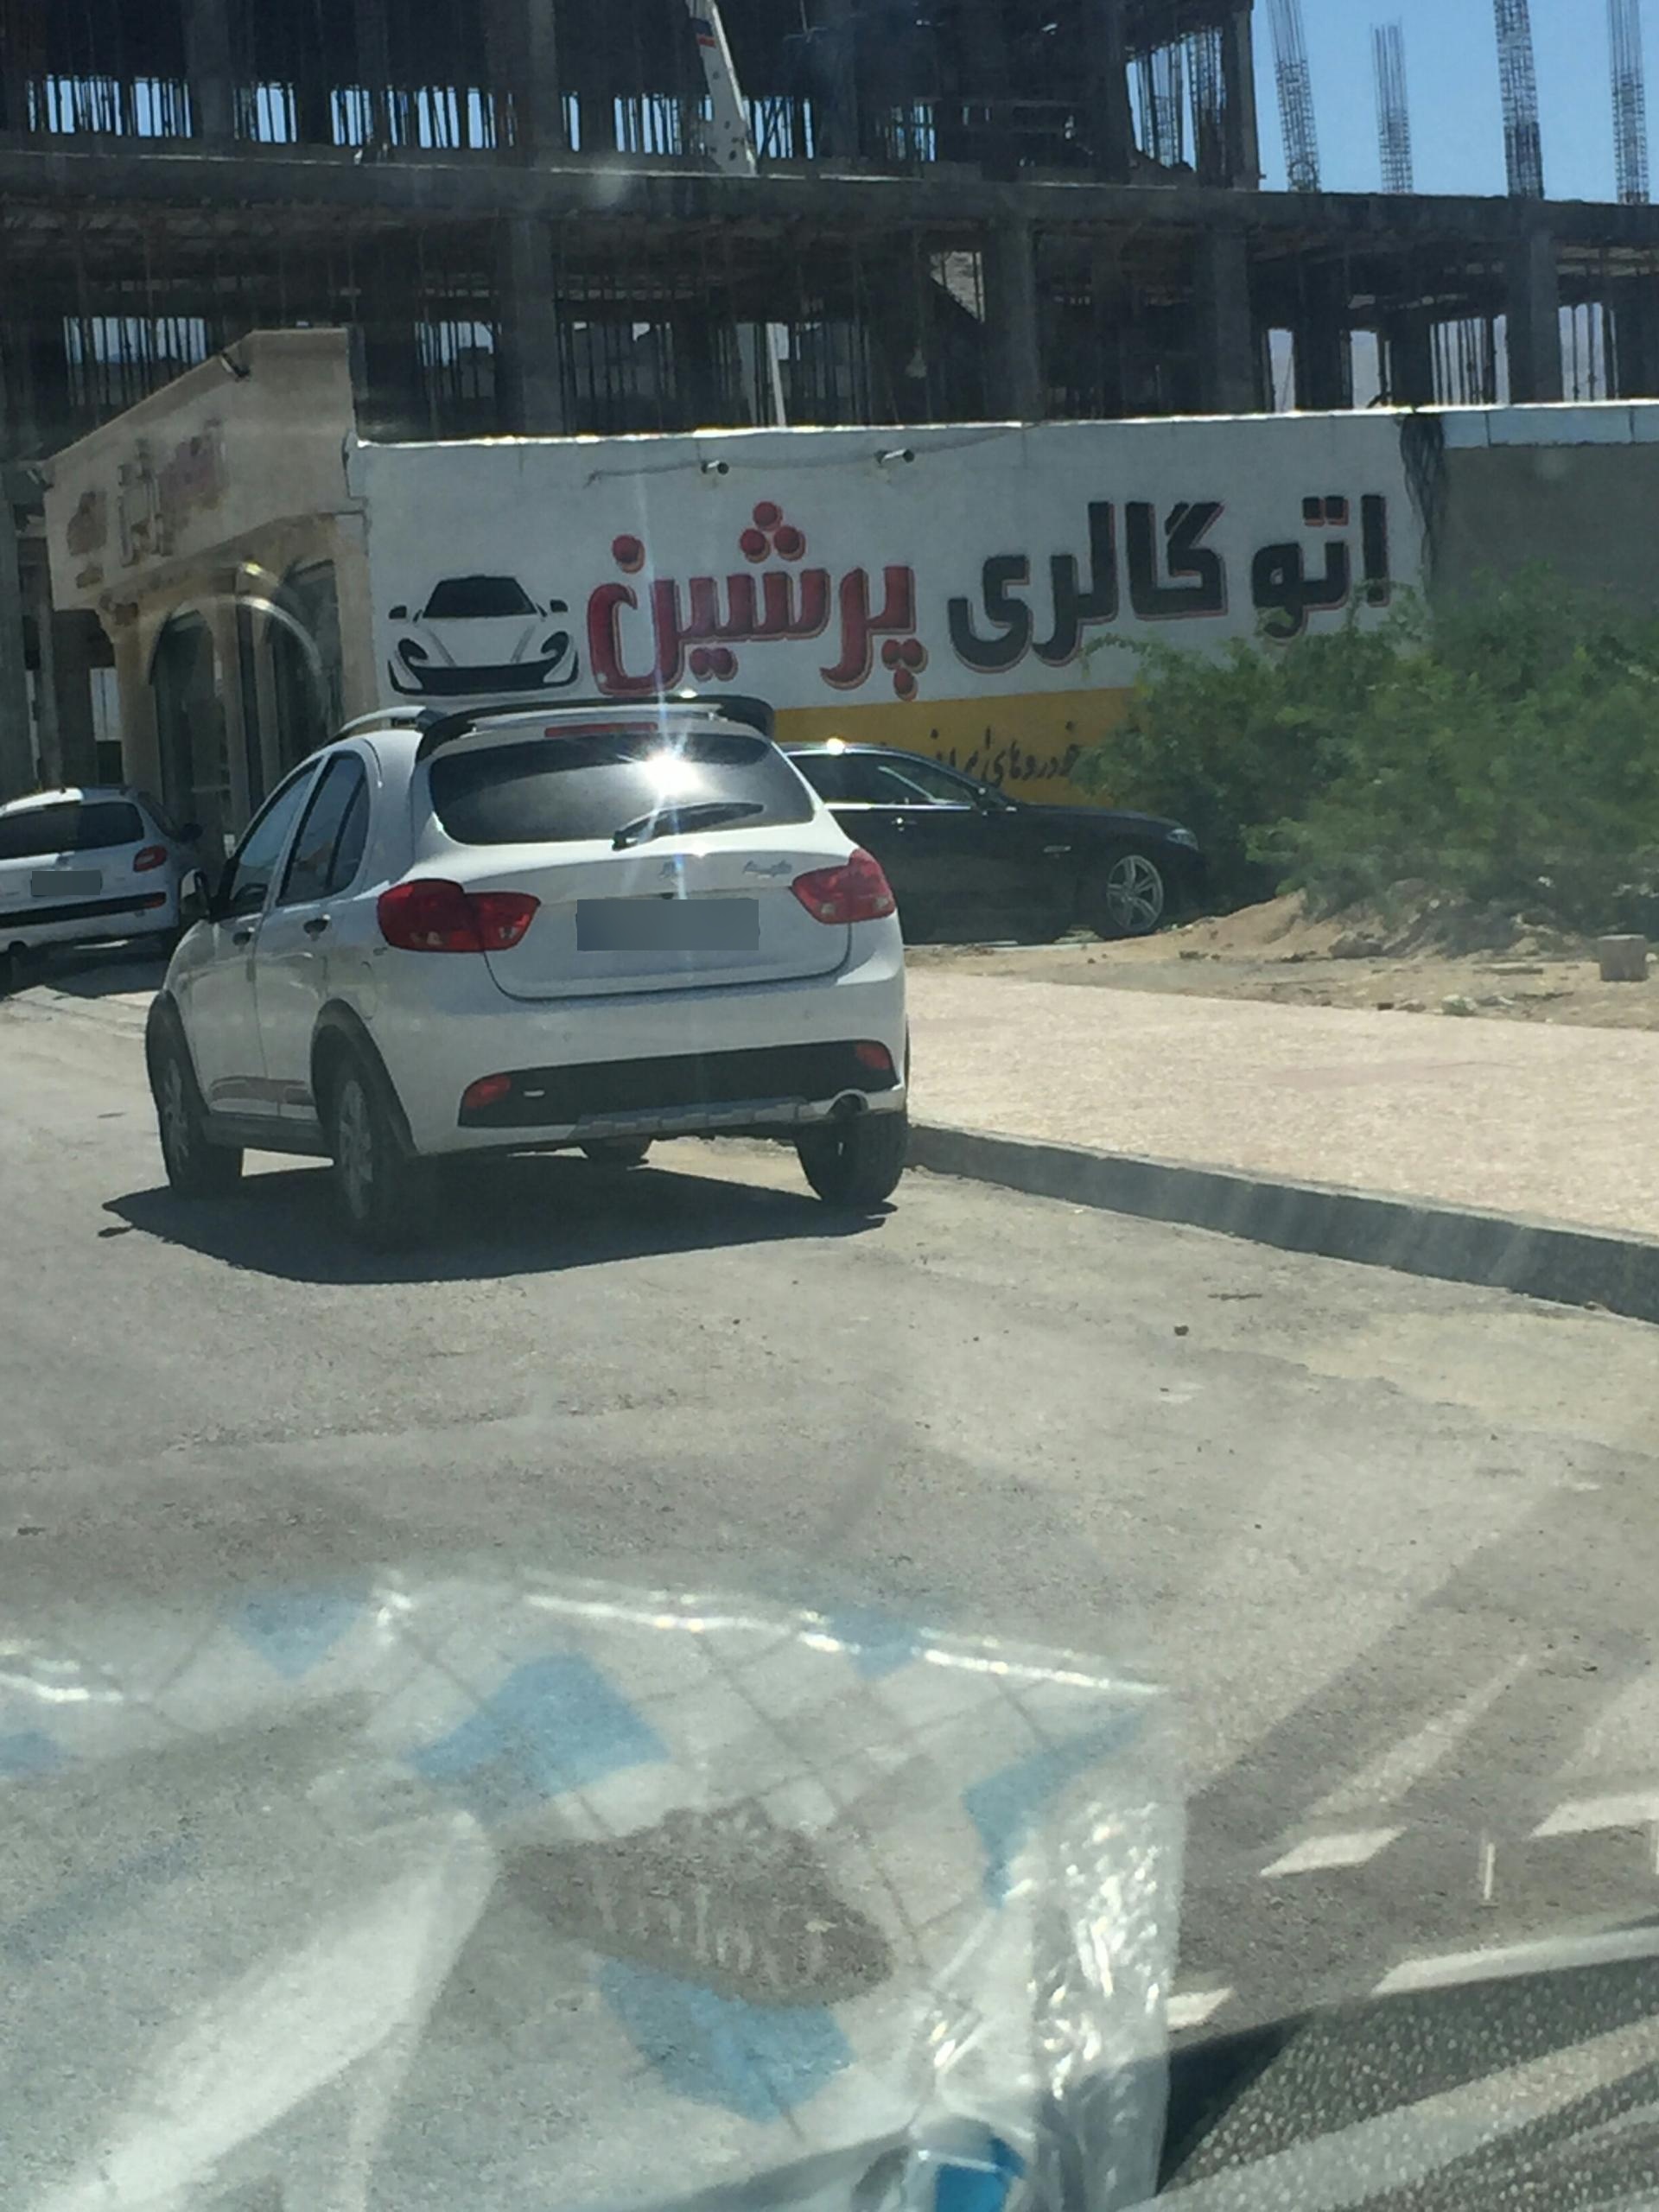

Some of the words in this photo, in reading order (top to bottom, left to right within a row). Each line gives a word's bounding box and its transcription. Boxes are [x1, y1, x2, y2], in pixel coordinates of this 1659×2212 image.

[588, 500, 928, 701] پرشین
[948, 500, 1226, 673] گالری
[1252, 494, 1389, 641] اتو
